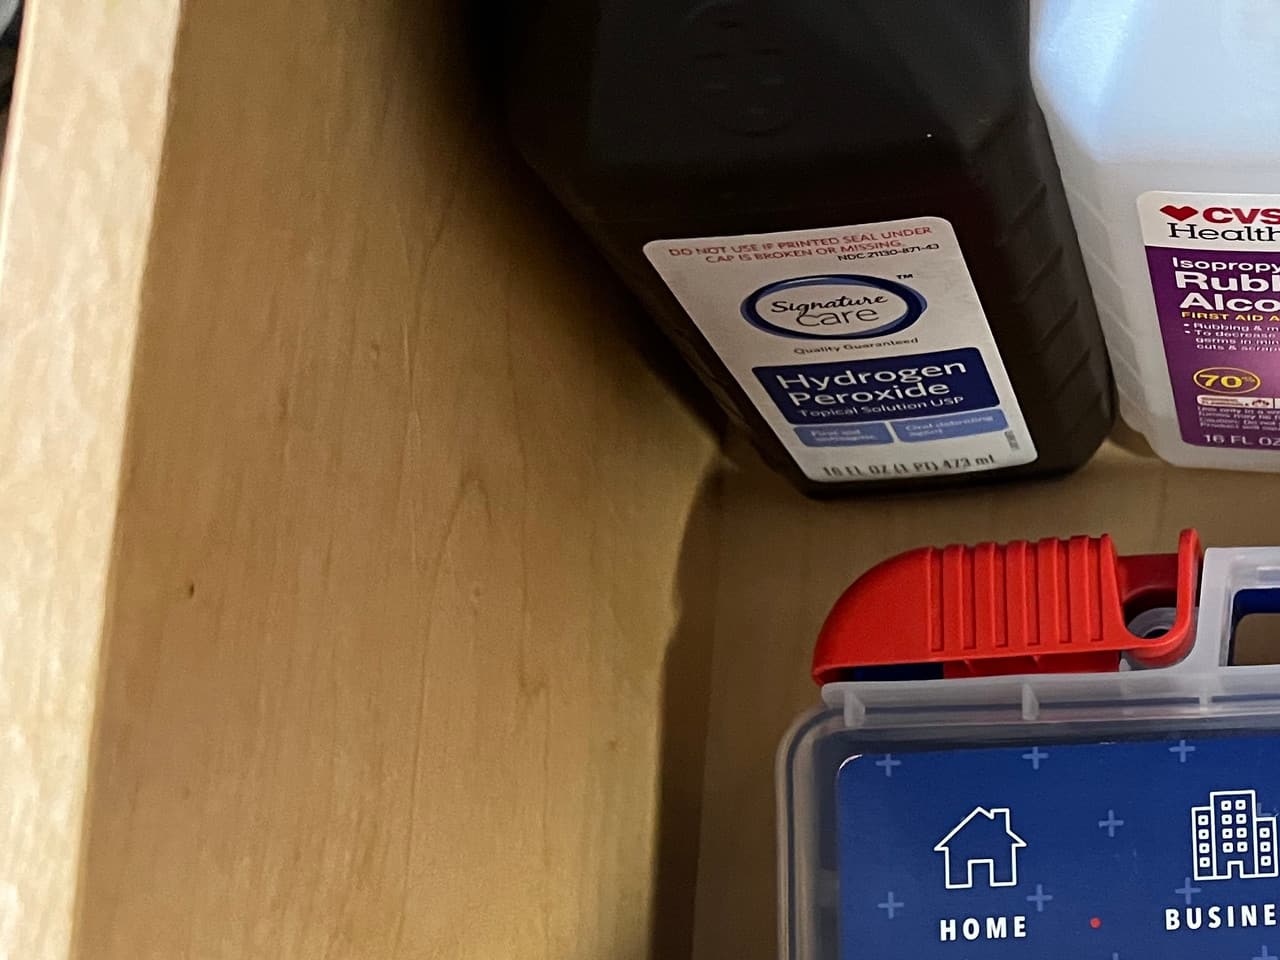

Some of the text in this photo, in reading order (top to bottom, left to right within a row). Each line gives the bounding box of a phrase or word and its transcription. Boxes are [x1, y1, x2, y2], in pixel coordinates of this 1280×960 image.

[669, 227, 932, 256] DO NOT USE IF PRINTED SEAL UNDER
[705, 255, 734, 263] CAP
[740, 253, 752, 261] IS
[754, 249, 812, 260] BROKEN
[816, 246, 835, 256] OR
[837, 252, 865, 262] NDC
[771, 295, 888, 318] Signature
[1181, 311, 1229, 321] FIRST
[1235, 313, 1263, 322] AID
[1193, 322, 1249, 332] Rubbing
[1215, 330, 1276, 338] decrease
[794, 338, 919, 355] Quality Guaranteed
[776, 361, 967, 389] Hydrogen
[788, 382, 950, 406] Peroxide
[799, 396, 965, 419] Topical Solution USP
[1204, 434, 1224, 443] 16
[1231, 435, 1253, 445] FL
[940, 915, 1028, 942] HOME
